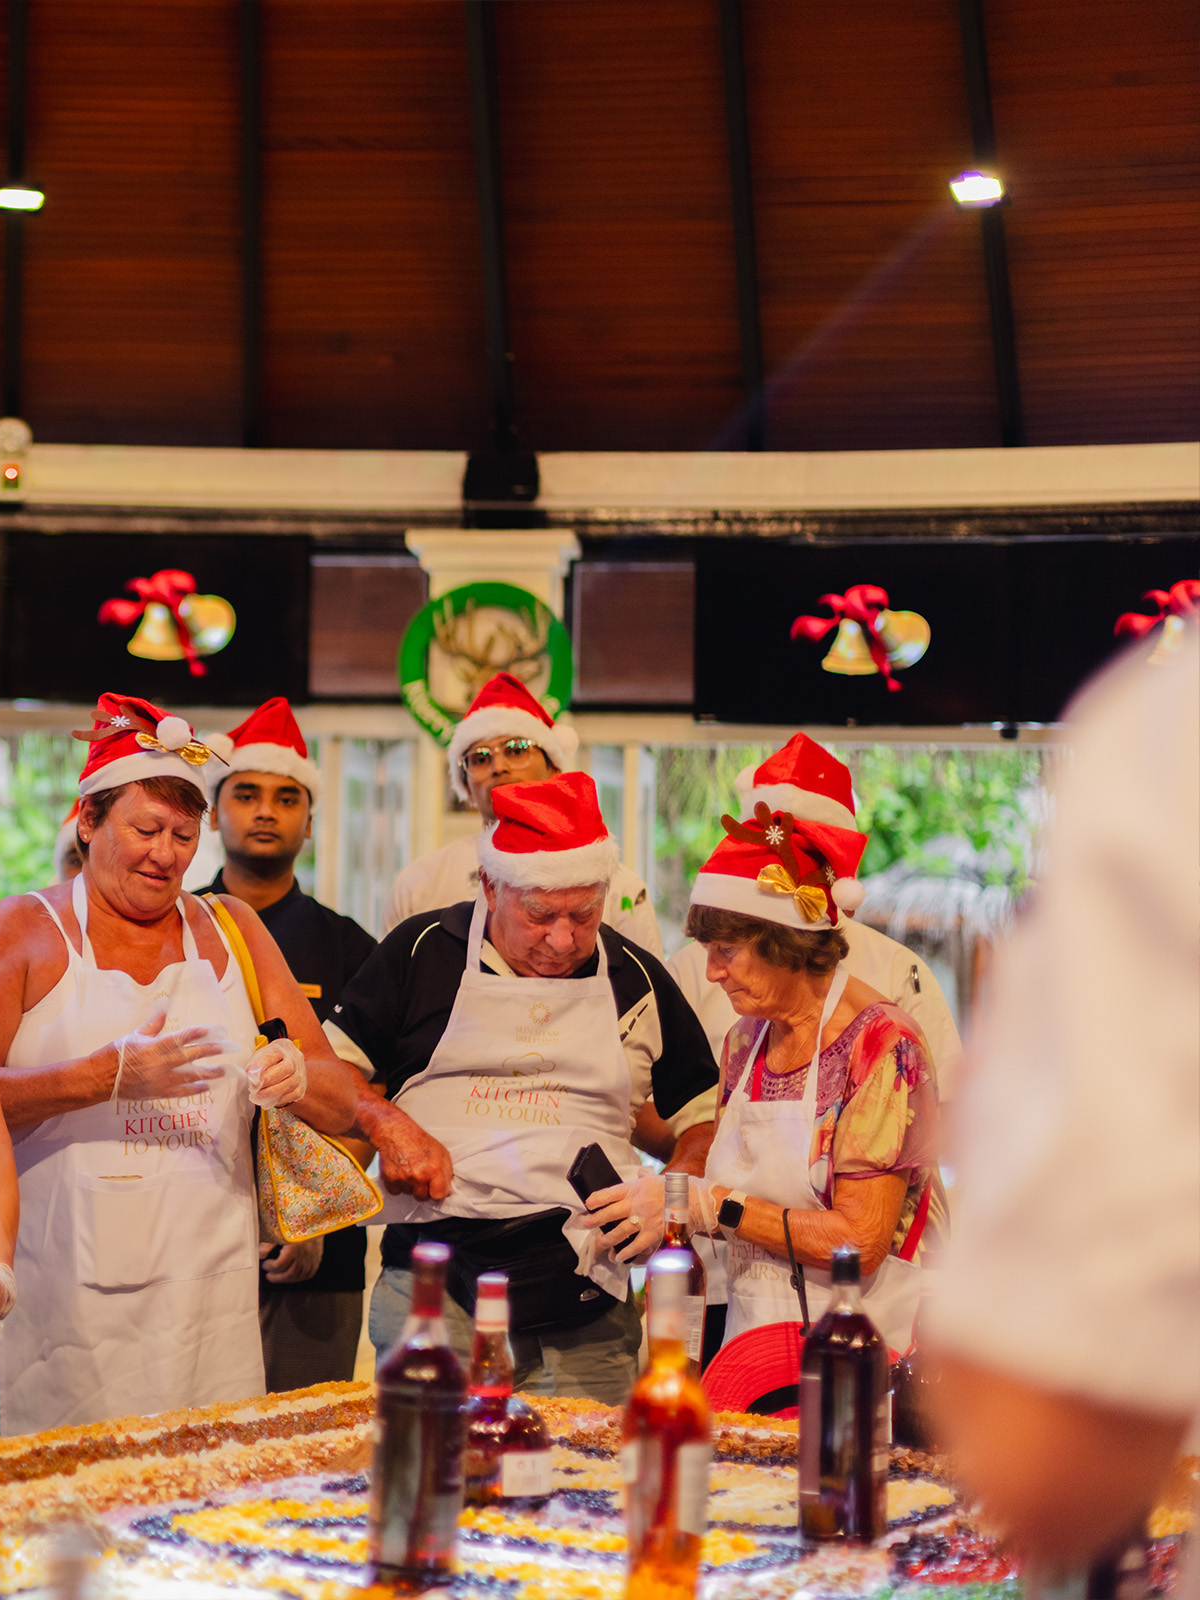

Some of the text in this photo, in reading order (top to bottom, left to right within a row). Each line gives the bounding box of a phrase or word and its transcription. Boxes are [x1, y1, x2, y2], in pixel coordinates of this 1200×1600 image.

[177, 1089, 214, 1109] OUR
[470, 1085, 560, 1109] KITCHEN
[125, 1109, 208, 1136] KITCHEN
[462, 1100, 562, 1127] TO YOURS
[120, 1128, 214, 1156] TO YOURS
